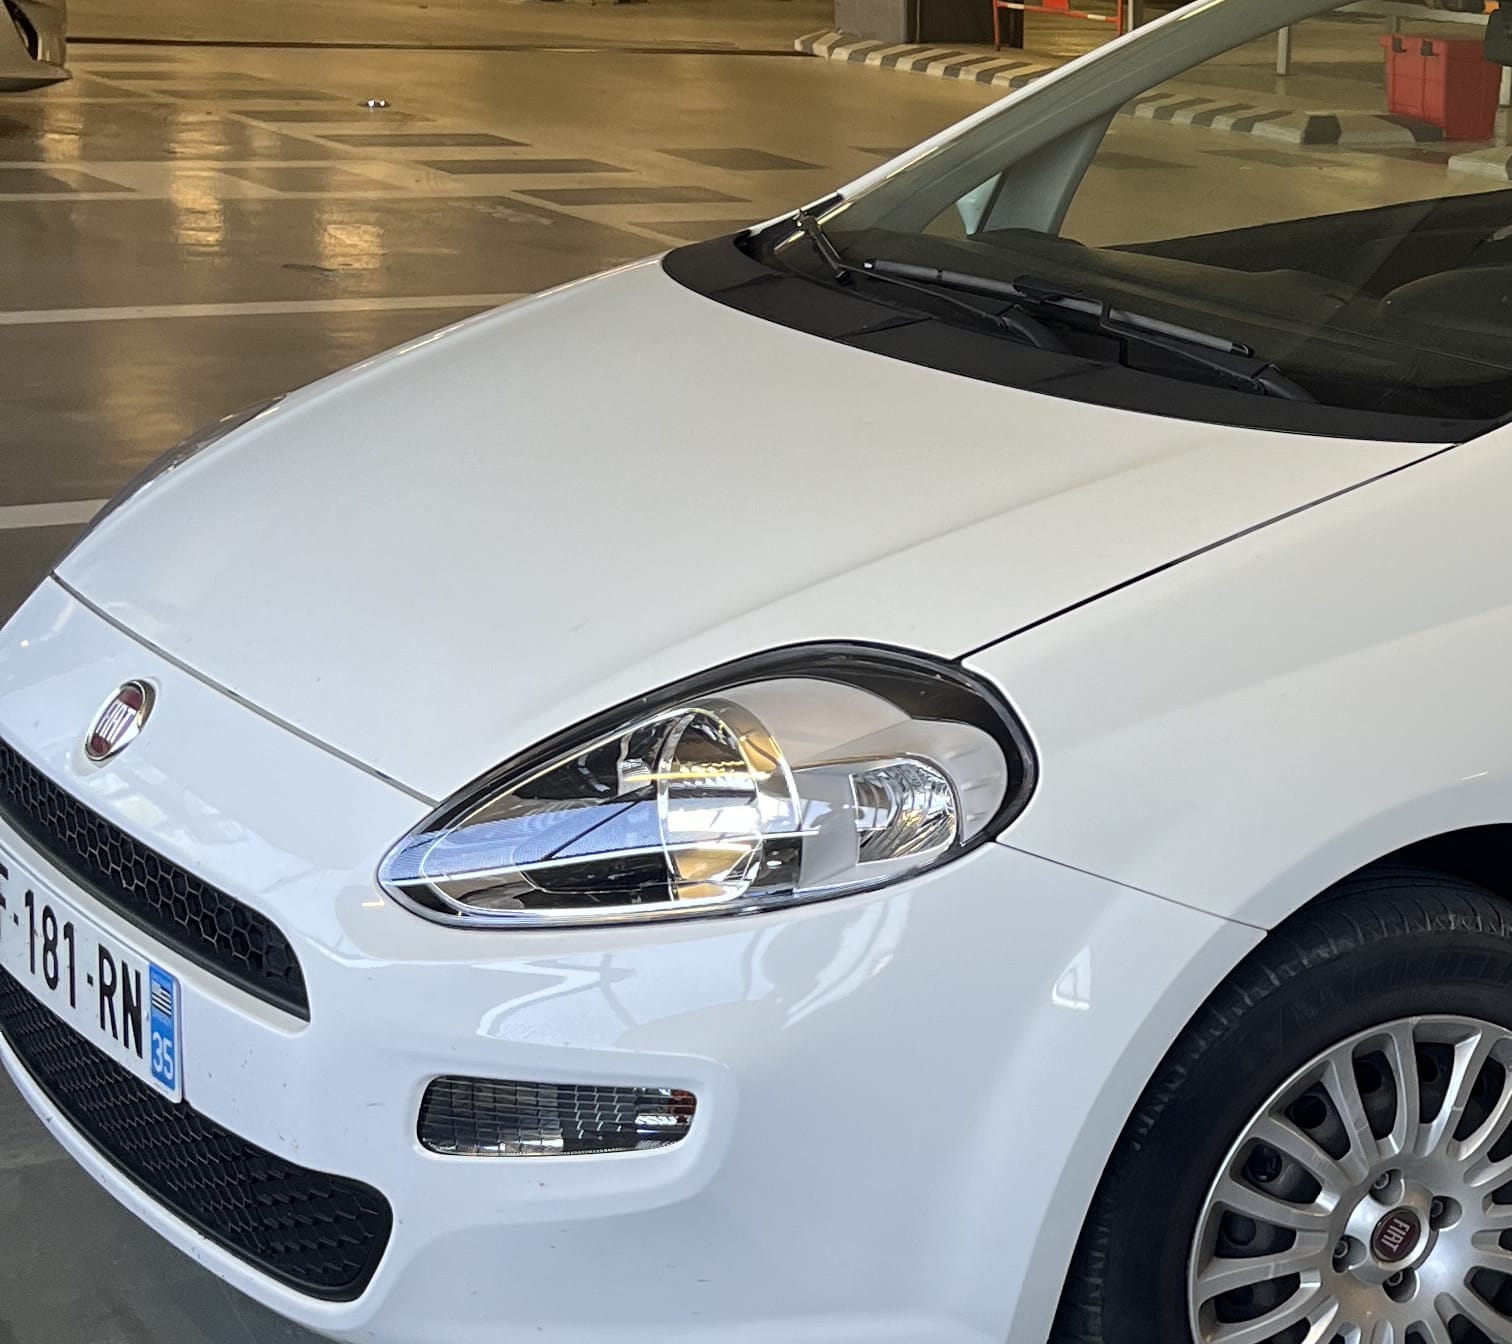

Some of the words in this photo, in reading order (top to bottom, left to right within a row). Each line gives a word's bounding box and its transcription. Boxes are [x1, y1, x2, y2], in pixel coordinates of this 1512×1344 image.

[95, 699, 137, 744] FIAT
[152, 1031, 174, 1080] 35
[1380, 1218, 1410, 1253] FIAT
